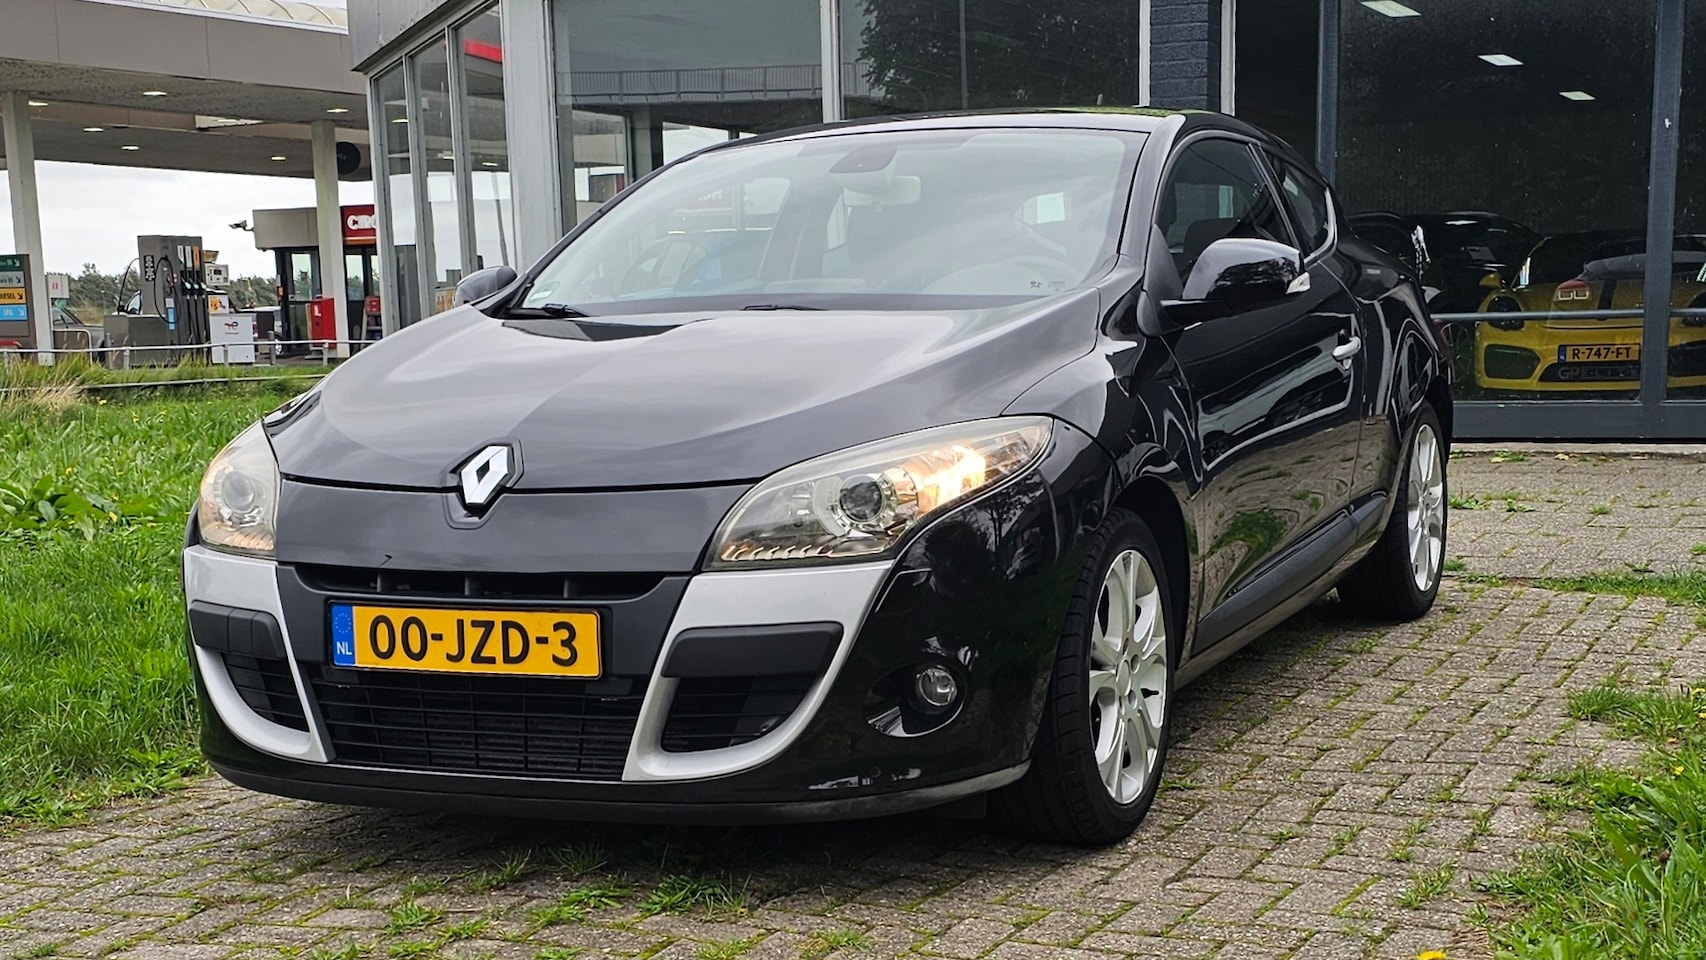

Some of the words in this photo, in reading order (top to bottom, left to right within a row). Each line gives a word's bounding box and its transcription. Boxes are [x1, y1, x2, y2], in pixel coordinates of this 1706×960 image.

[1572, 346, 1632, 360] R-747-FT
[369, 614, 578, 667] 00-JZD-3
[336, 641, 353, 656] NL
